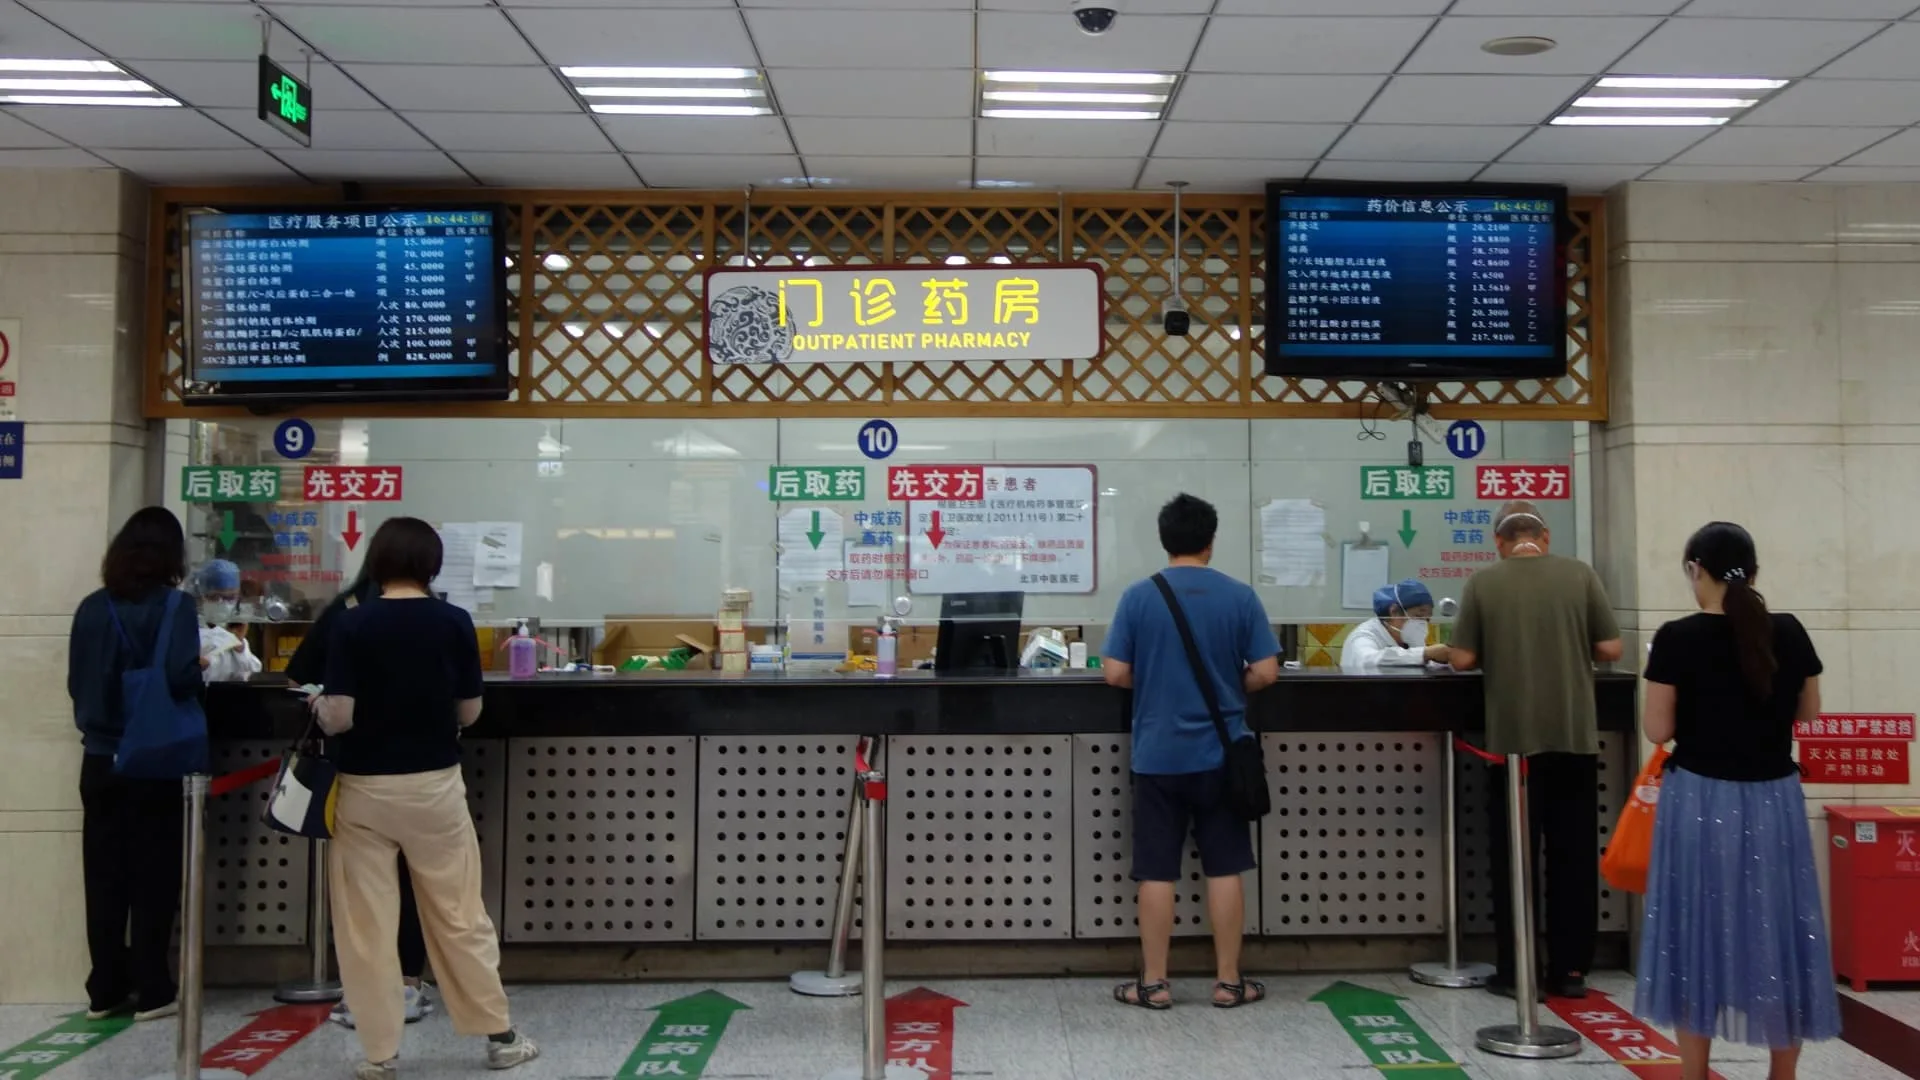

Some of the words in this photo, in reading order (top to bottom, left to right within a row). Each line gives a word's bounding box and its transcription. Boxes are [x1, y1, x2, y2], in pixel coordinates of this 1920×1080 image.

[1368, 199, 1468, 212] 药价信息公示
[268, 214, 418, 229] 医疗服务项目公示
[1473, 214, 1493, 222] 价格
[404, 228, 426, 236] 价格
[1528, 224, 1537, 232] 乙
[404, 238, 444, 246] 15.0000
[1528, 236, 1537, 244] 乙
[404, 250, 444, 258] 70.0000
[1528, 248, 1537, 256] 乙
[404, 263, 444, 271] 45.0000
[1528, 260, 1537, 268] 乙
[404, 275, 444, 283] 50.0000
[405, 288, 445, 296] 75.0000
[377, 301, 399, 310] 人次
[405, 301, 446, 309] 80.0000
[778, 277, 1040, 326] 门诊药房
[377, 315, 400, 324] 人次
[405, 315, 452, 323] 170.0000
[377, 327, 400, 336] 人次
[405, 327, 452, 336] 215.0000
[377, 339, 400, 349] 人次
[406, 340, 452, 348] 100.0000
[793, 334, 914, 351] OUTPATIENT
[922, 332, 1031, 349] PHARMACY
[0, 433, 15, 445] 在
[284, 426, 304, 452] 9
[863, 427, 893, 452] 10
[1452, 426, 1479, 451] 11
[186, 470, 278, 498] 后取药
[307, 470, 398, 498] 先交方
[773, 471, 862, 497] 后取药
[892, 470, 980, 497] 先交方
[1365, 469, 1451, 496] 后取药
[1480, 469, 1567, 496] 先交方
[854, 511, 902, 526] 中成药
[1444, 509, 1491, 525] 中成药
[1452, 529, 1484, 544] 西药
[1020, 574, 1080, 583] 北京中医医院
[1796, 719, 1912, 736] 消防设施严禁遮挡
[1808, 748, 1901, 761] 灭火器摆放处
[1825, 764, 1885, 776] 严禁移动
[1896, 830, 1920, 857] 灭
[1347, 1014, 1440, 1064] 取药队
[1570, 1010, 1683, 1060] 交方队
[634, 1023, 711, 1076] 取药队
